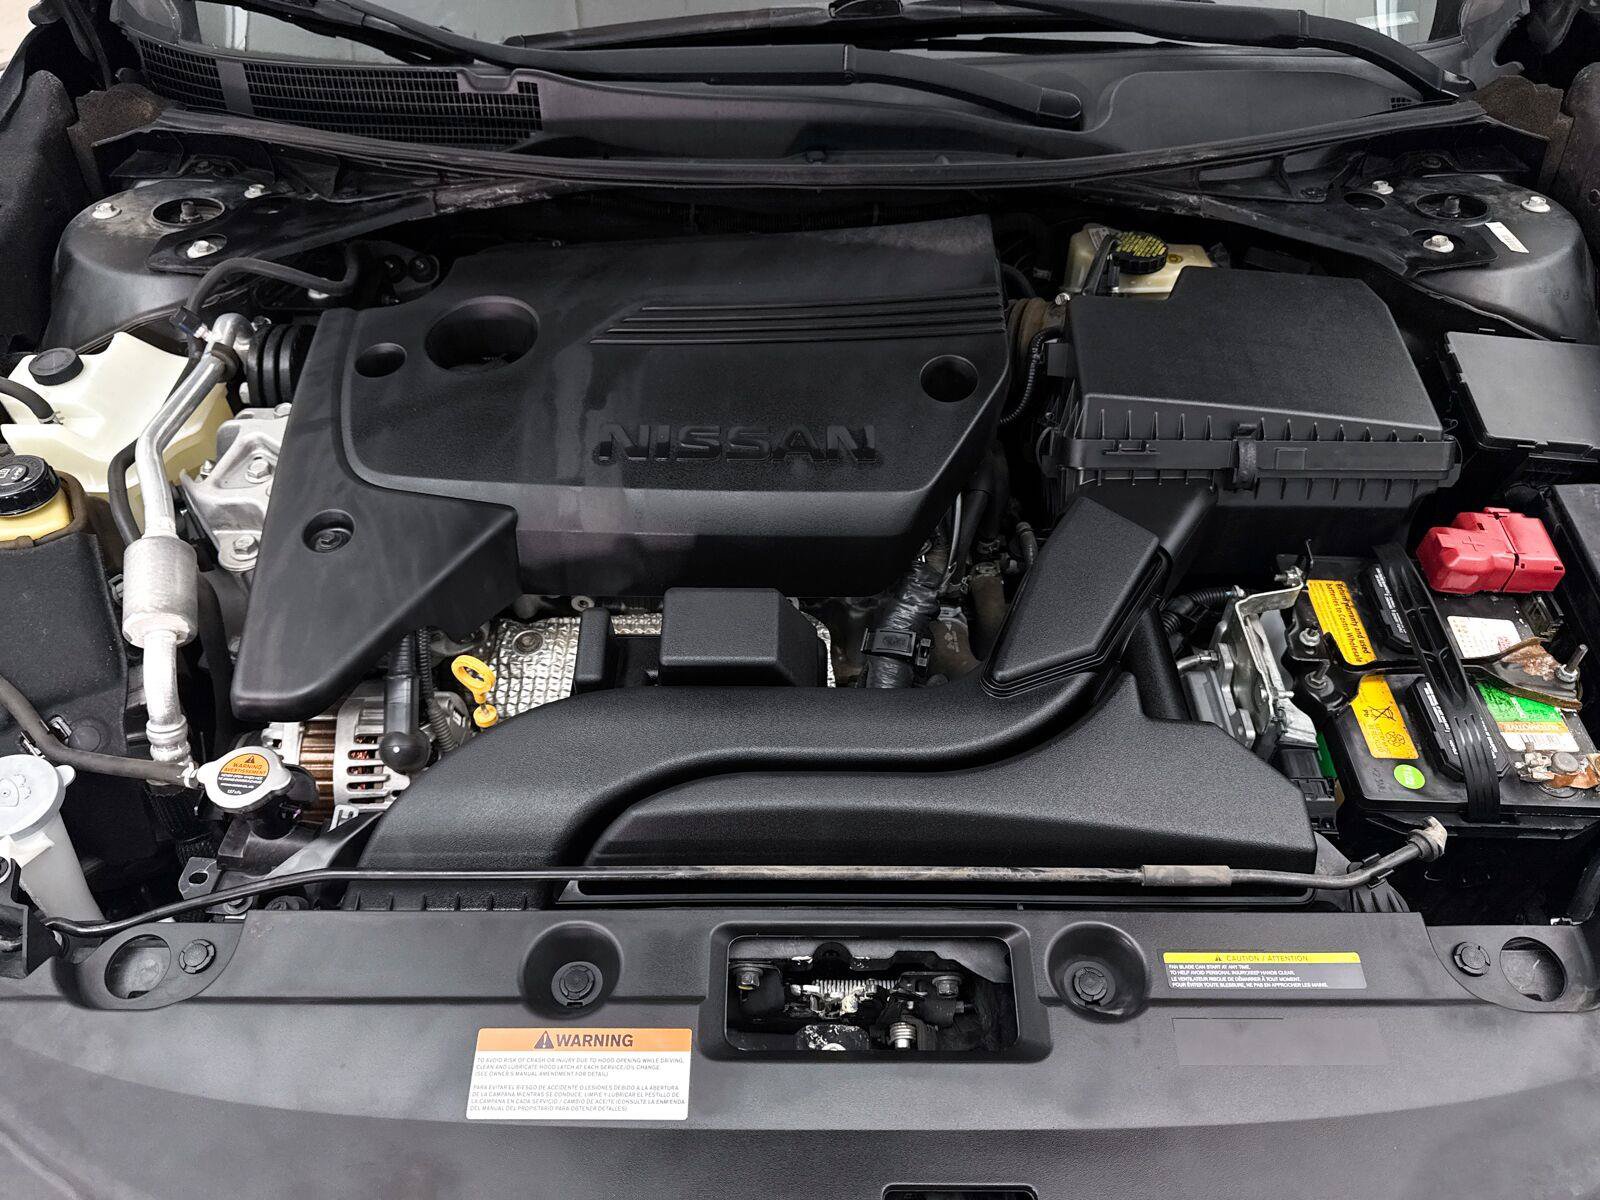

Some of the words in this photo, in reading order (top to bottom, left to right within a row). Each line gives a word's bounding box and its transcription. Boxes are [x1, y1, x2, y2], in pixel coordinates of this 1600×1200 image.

[594, 424, 878, 463] NISSAN
[1341, 602, 1359, 626] warranty
[1325, 583, 1342, 606] batteries
[1345, 632, 1363, 662] Wholesale
[1354, 627, 1365, 638] and
[1358, 639, 1371, 653] used
[223, 767, 267, 775] AVERTISSEMENT
[556, 1034, 634, 1047] WARNING
